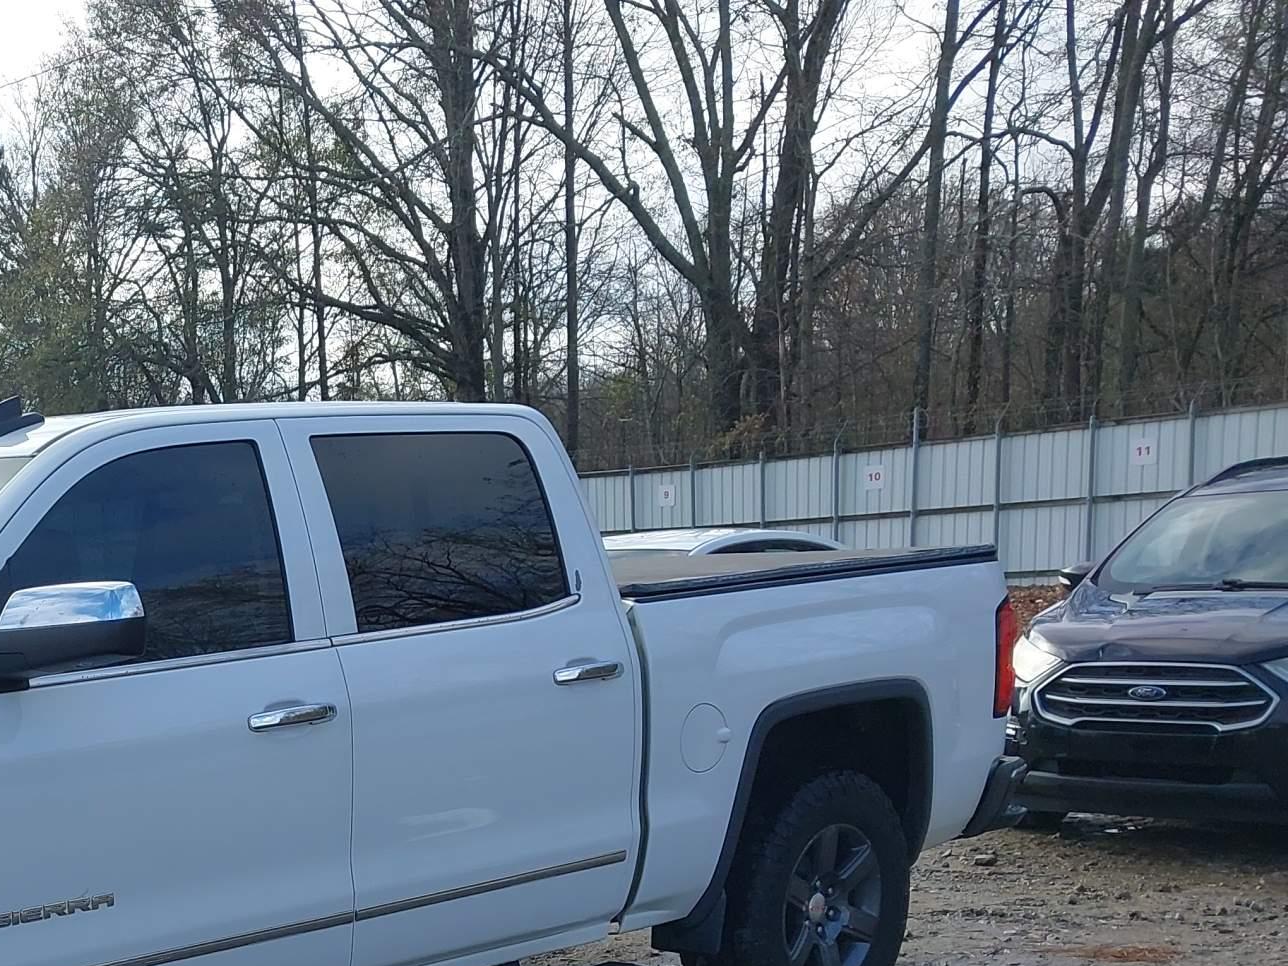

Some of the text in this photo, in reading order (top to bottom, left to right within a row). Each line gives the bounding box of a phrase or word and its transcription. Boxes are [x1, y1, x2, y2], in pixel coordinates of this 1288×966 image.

[1136, 446, 1151, 456] 11
[868, 471, 881, 482] 10
[663, 490, 670, 499] 9
